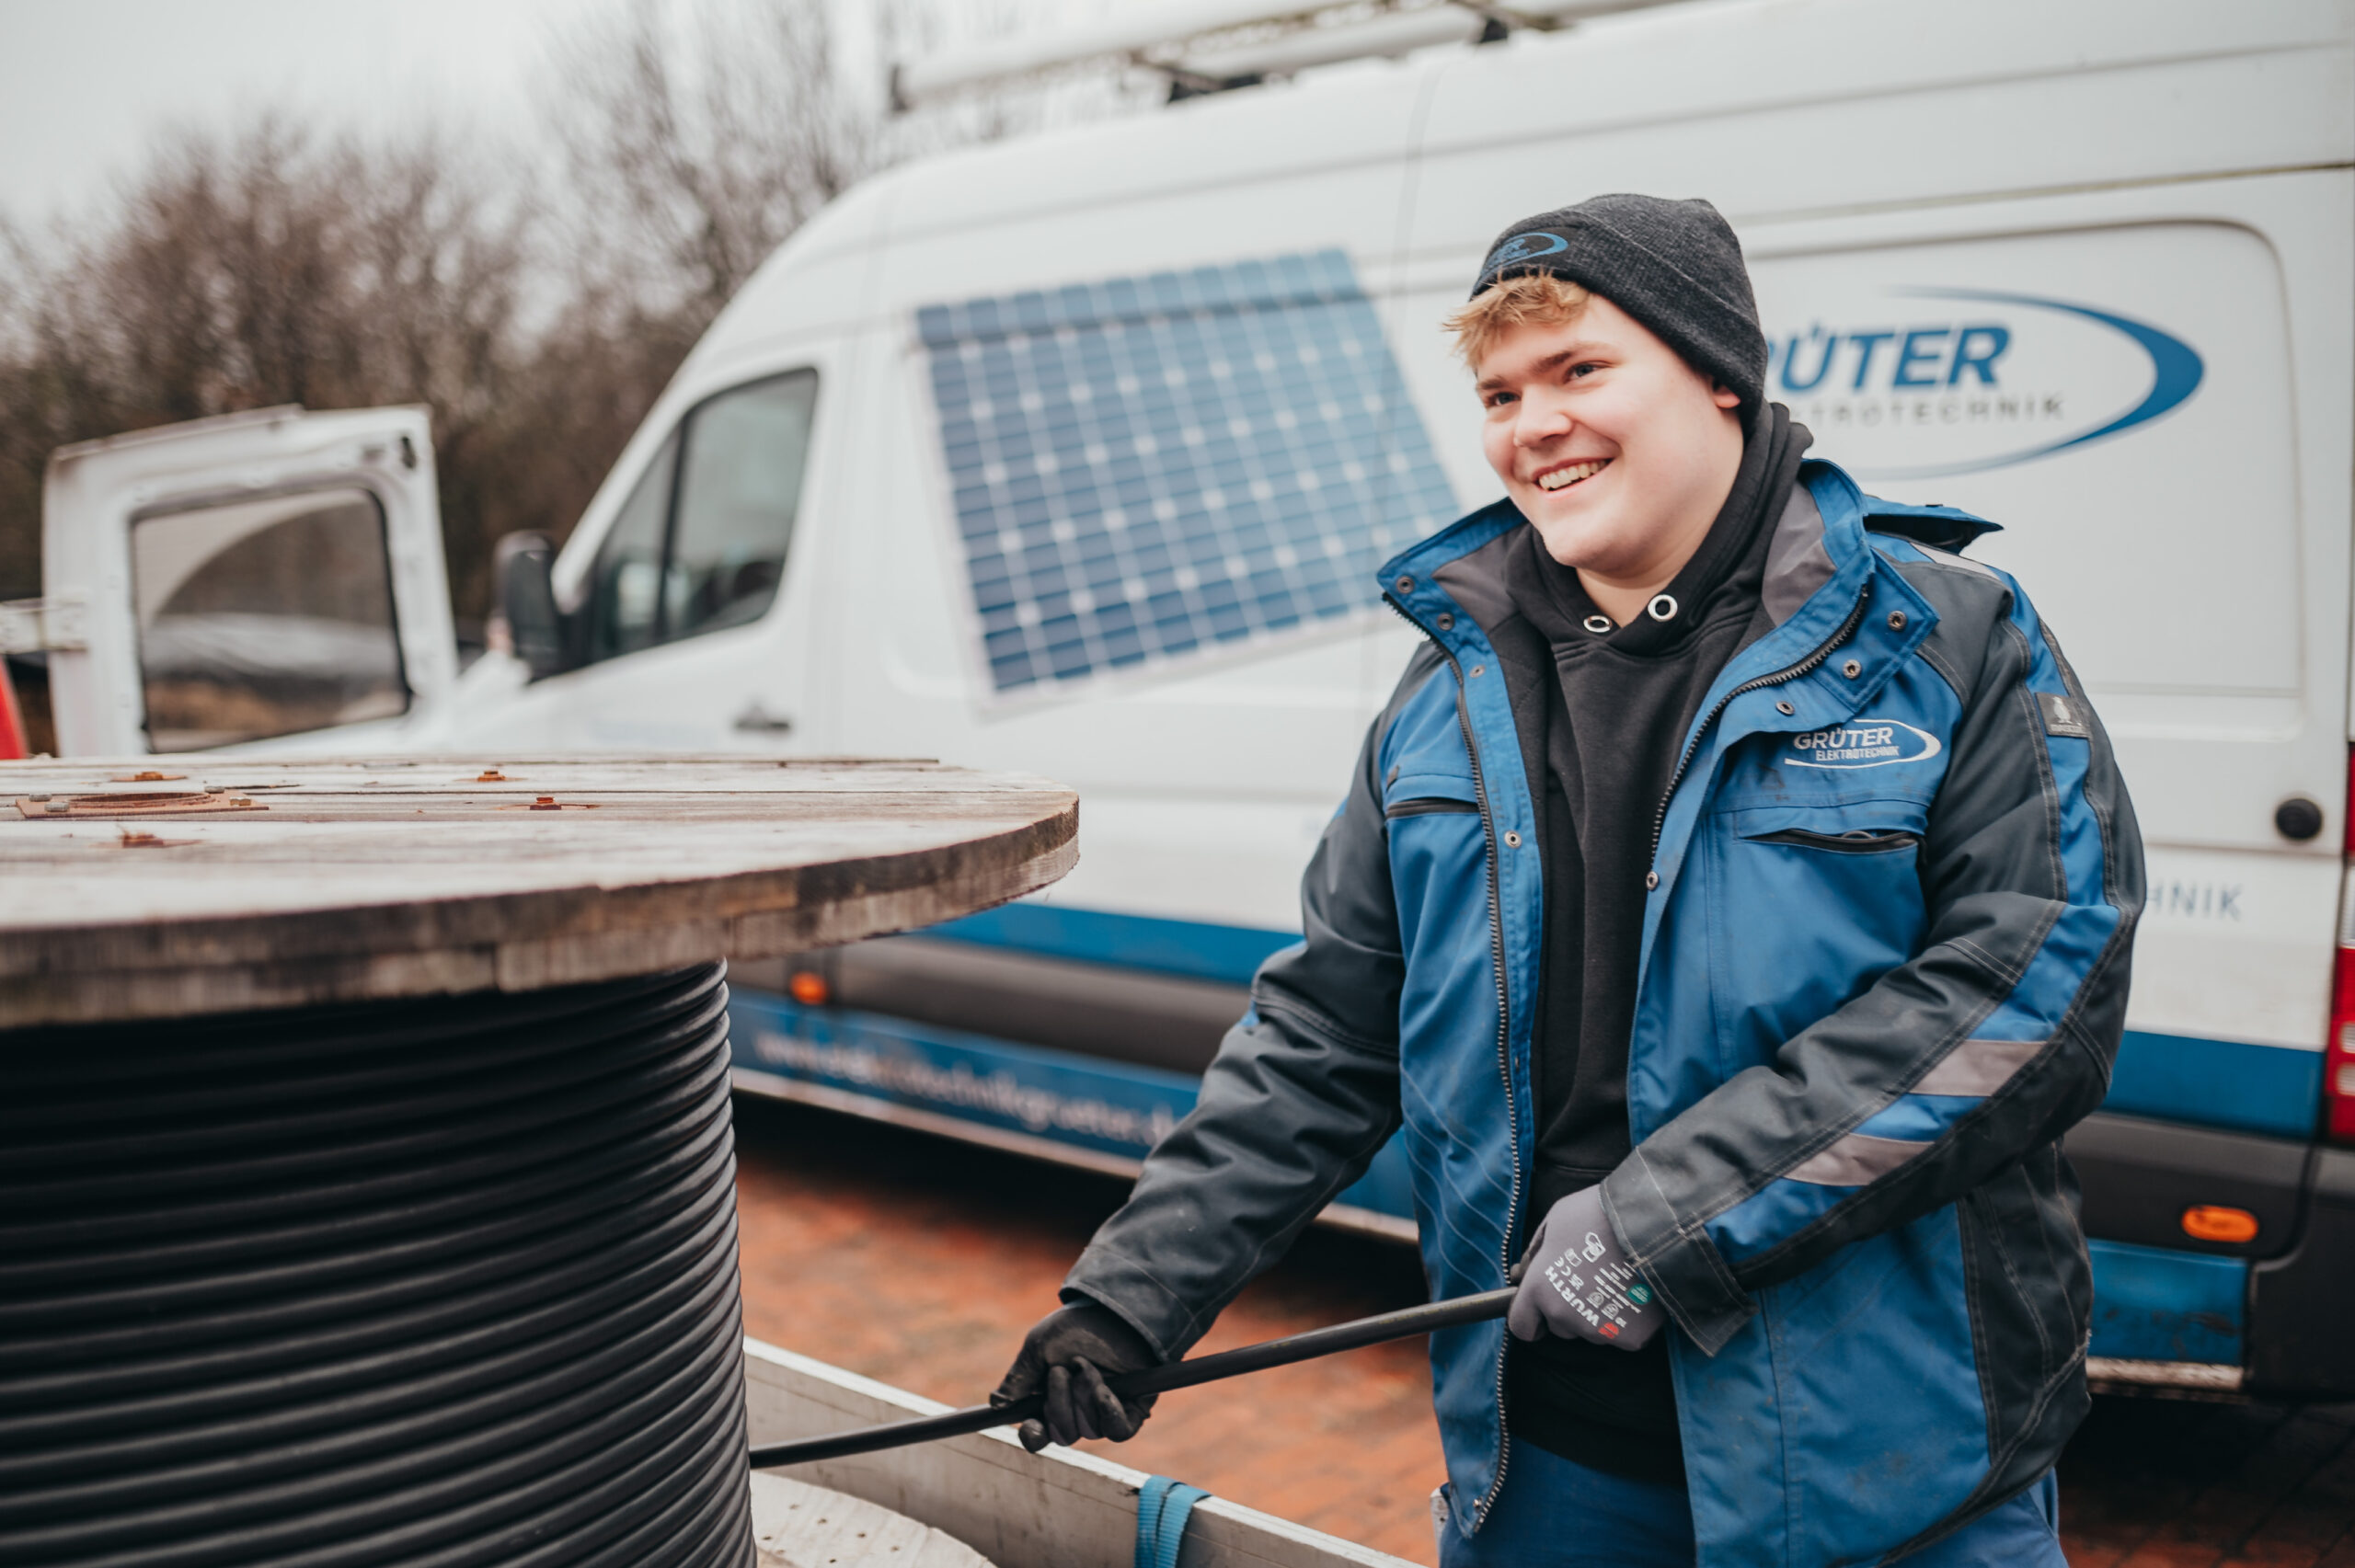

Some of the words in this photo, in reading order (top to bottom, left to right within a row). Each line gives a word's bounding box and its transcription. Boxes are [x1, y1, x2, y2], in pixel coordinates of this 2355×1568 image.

[1767, 321, 2011, 392] ÜTER
[1792, 394, 2066, 427] TROTECHNIK
[1816, 746, 1900, 761] ELEKTROTECHNIK
